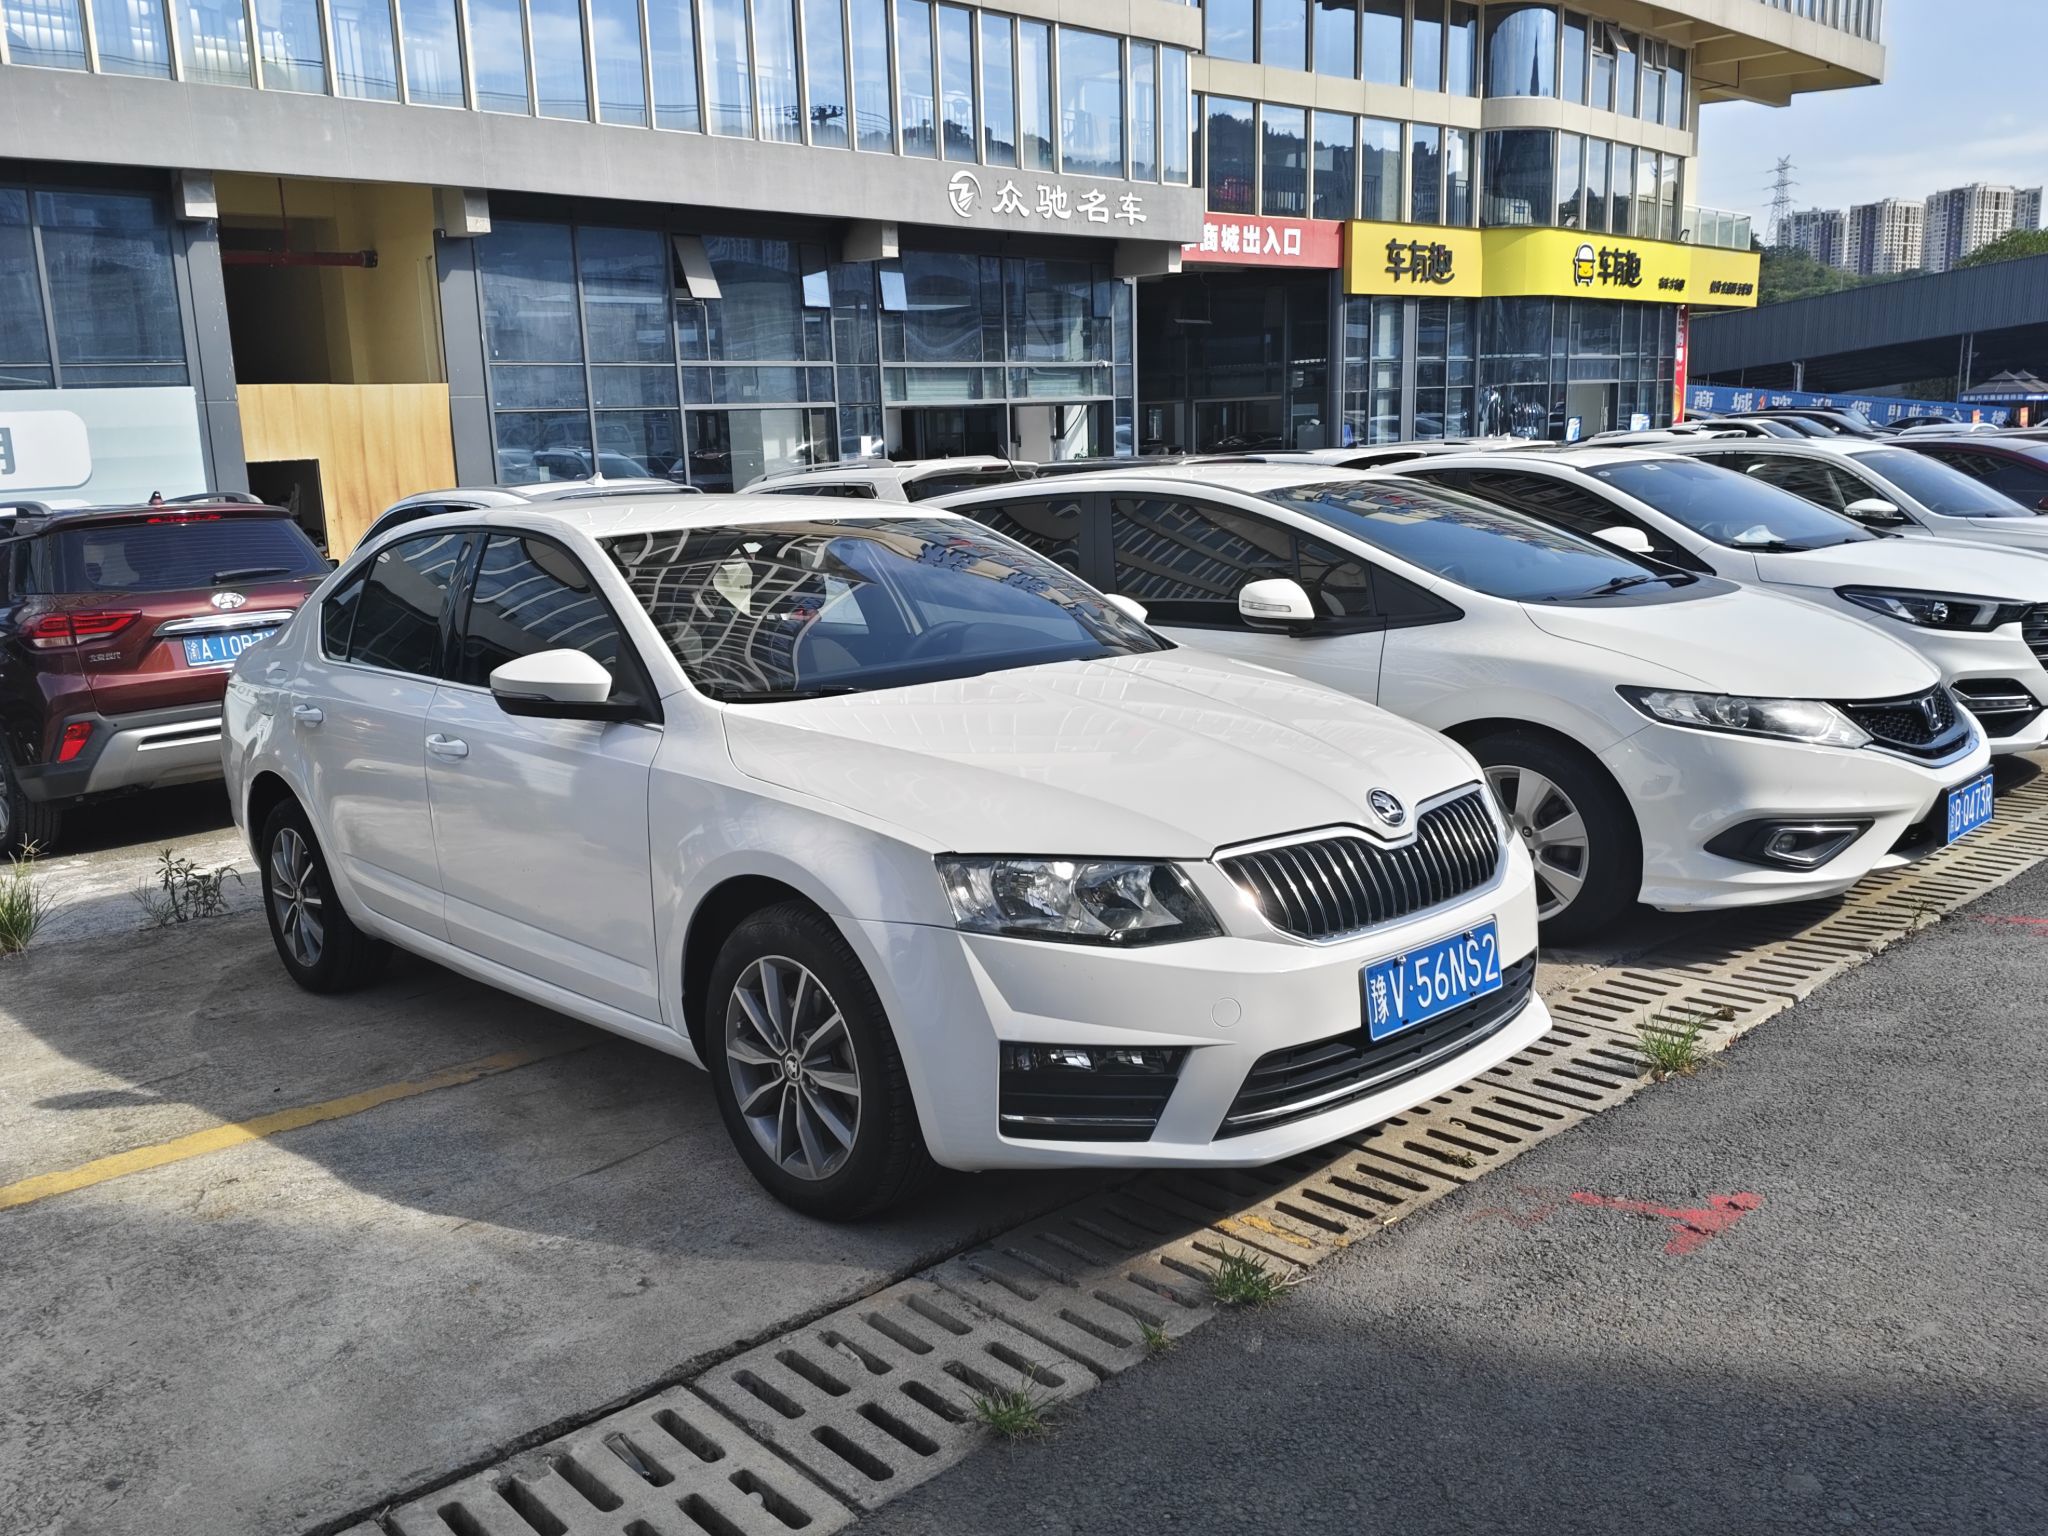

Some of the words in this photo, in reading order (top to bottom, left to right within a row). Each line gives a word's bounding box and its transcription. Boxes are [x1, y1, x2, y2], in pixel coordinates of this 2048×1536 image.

[991, 180, 1148, 226] 众驰名车
[1181, 222, 1301, 255] 商城出入口
[1385, 237, 1455, 285] 车有趣
